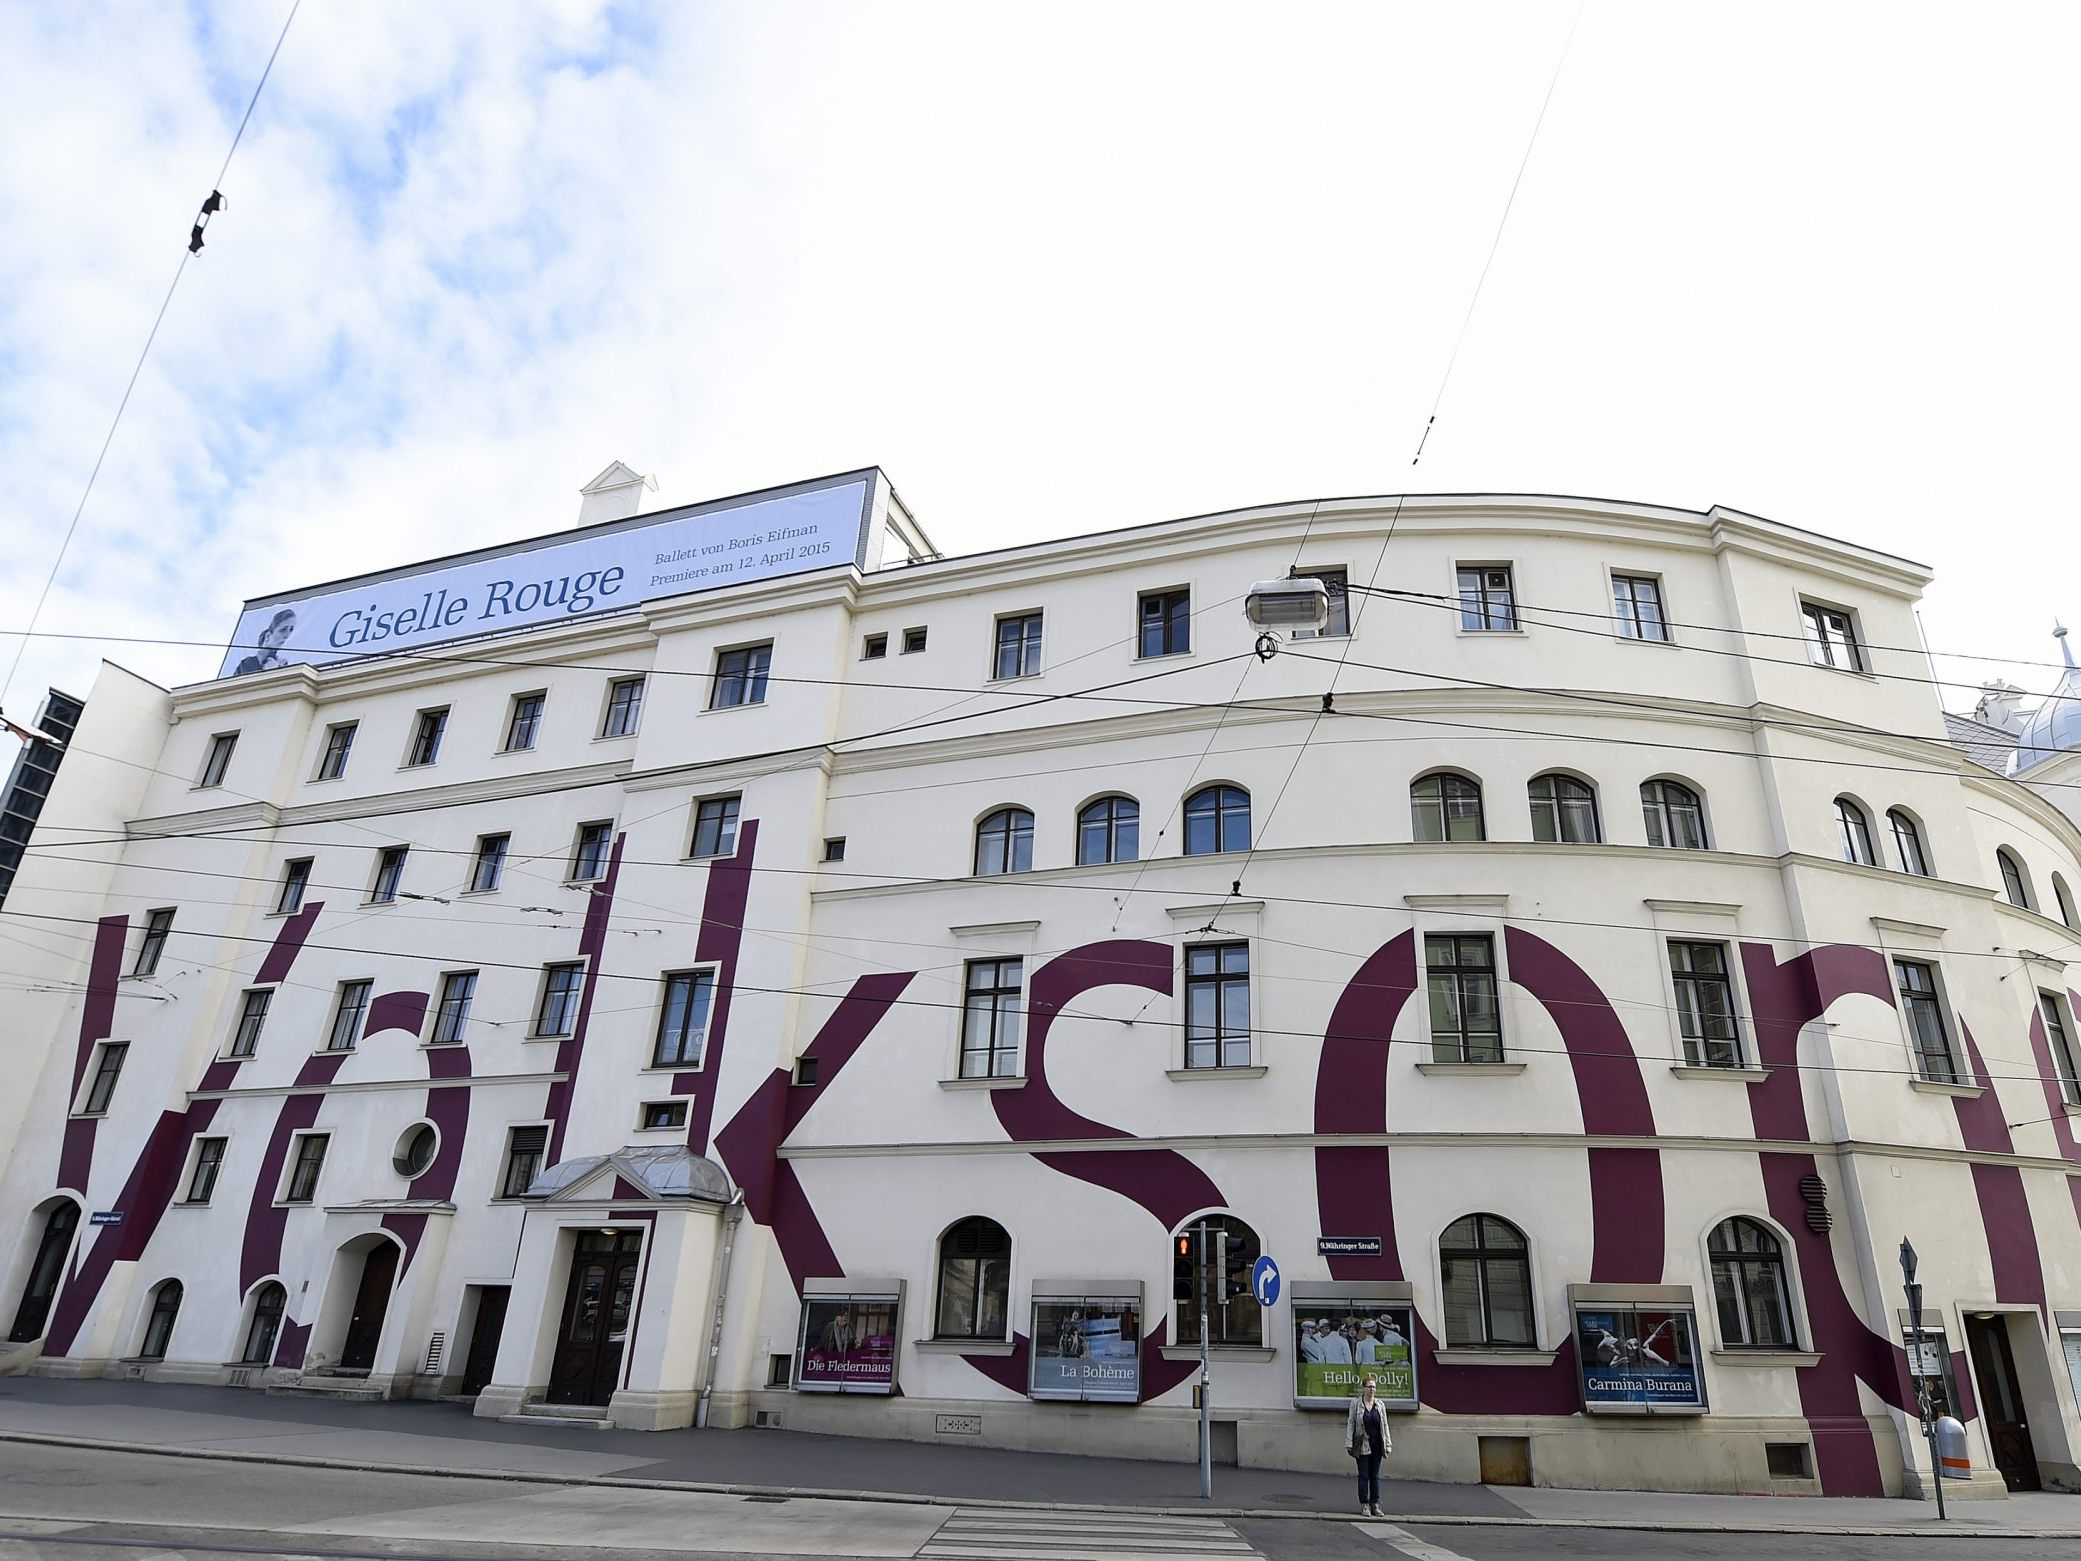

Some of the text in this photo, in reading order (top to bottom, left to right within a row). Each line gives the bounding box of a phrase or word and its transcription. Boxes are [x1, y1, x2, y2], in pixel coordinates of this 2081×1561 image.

[654, 524, 818, 565] Ballett von Boris Eifman
[649, 541, 831, 587] Premiere am 12. April 2015
[328, 566, 625, 649] Giselle Rouge
[807, 1359, 891, 1373] Die Fledermaus
[1060, 1365, 1135, 1379] La Bohème
[1323, 1370, 1363, 1386] Hello,
[1588, 1377, 1692, 1392] Carmina Burana
